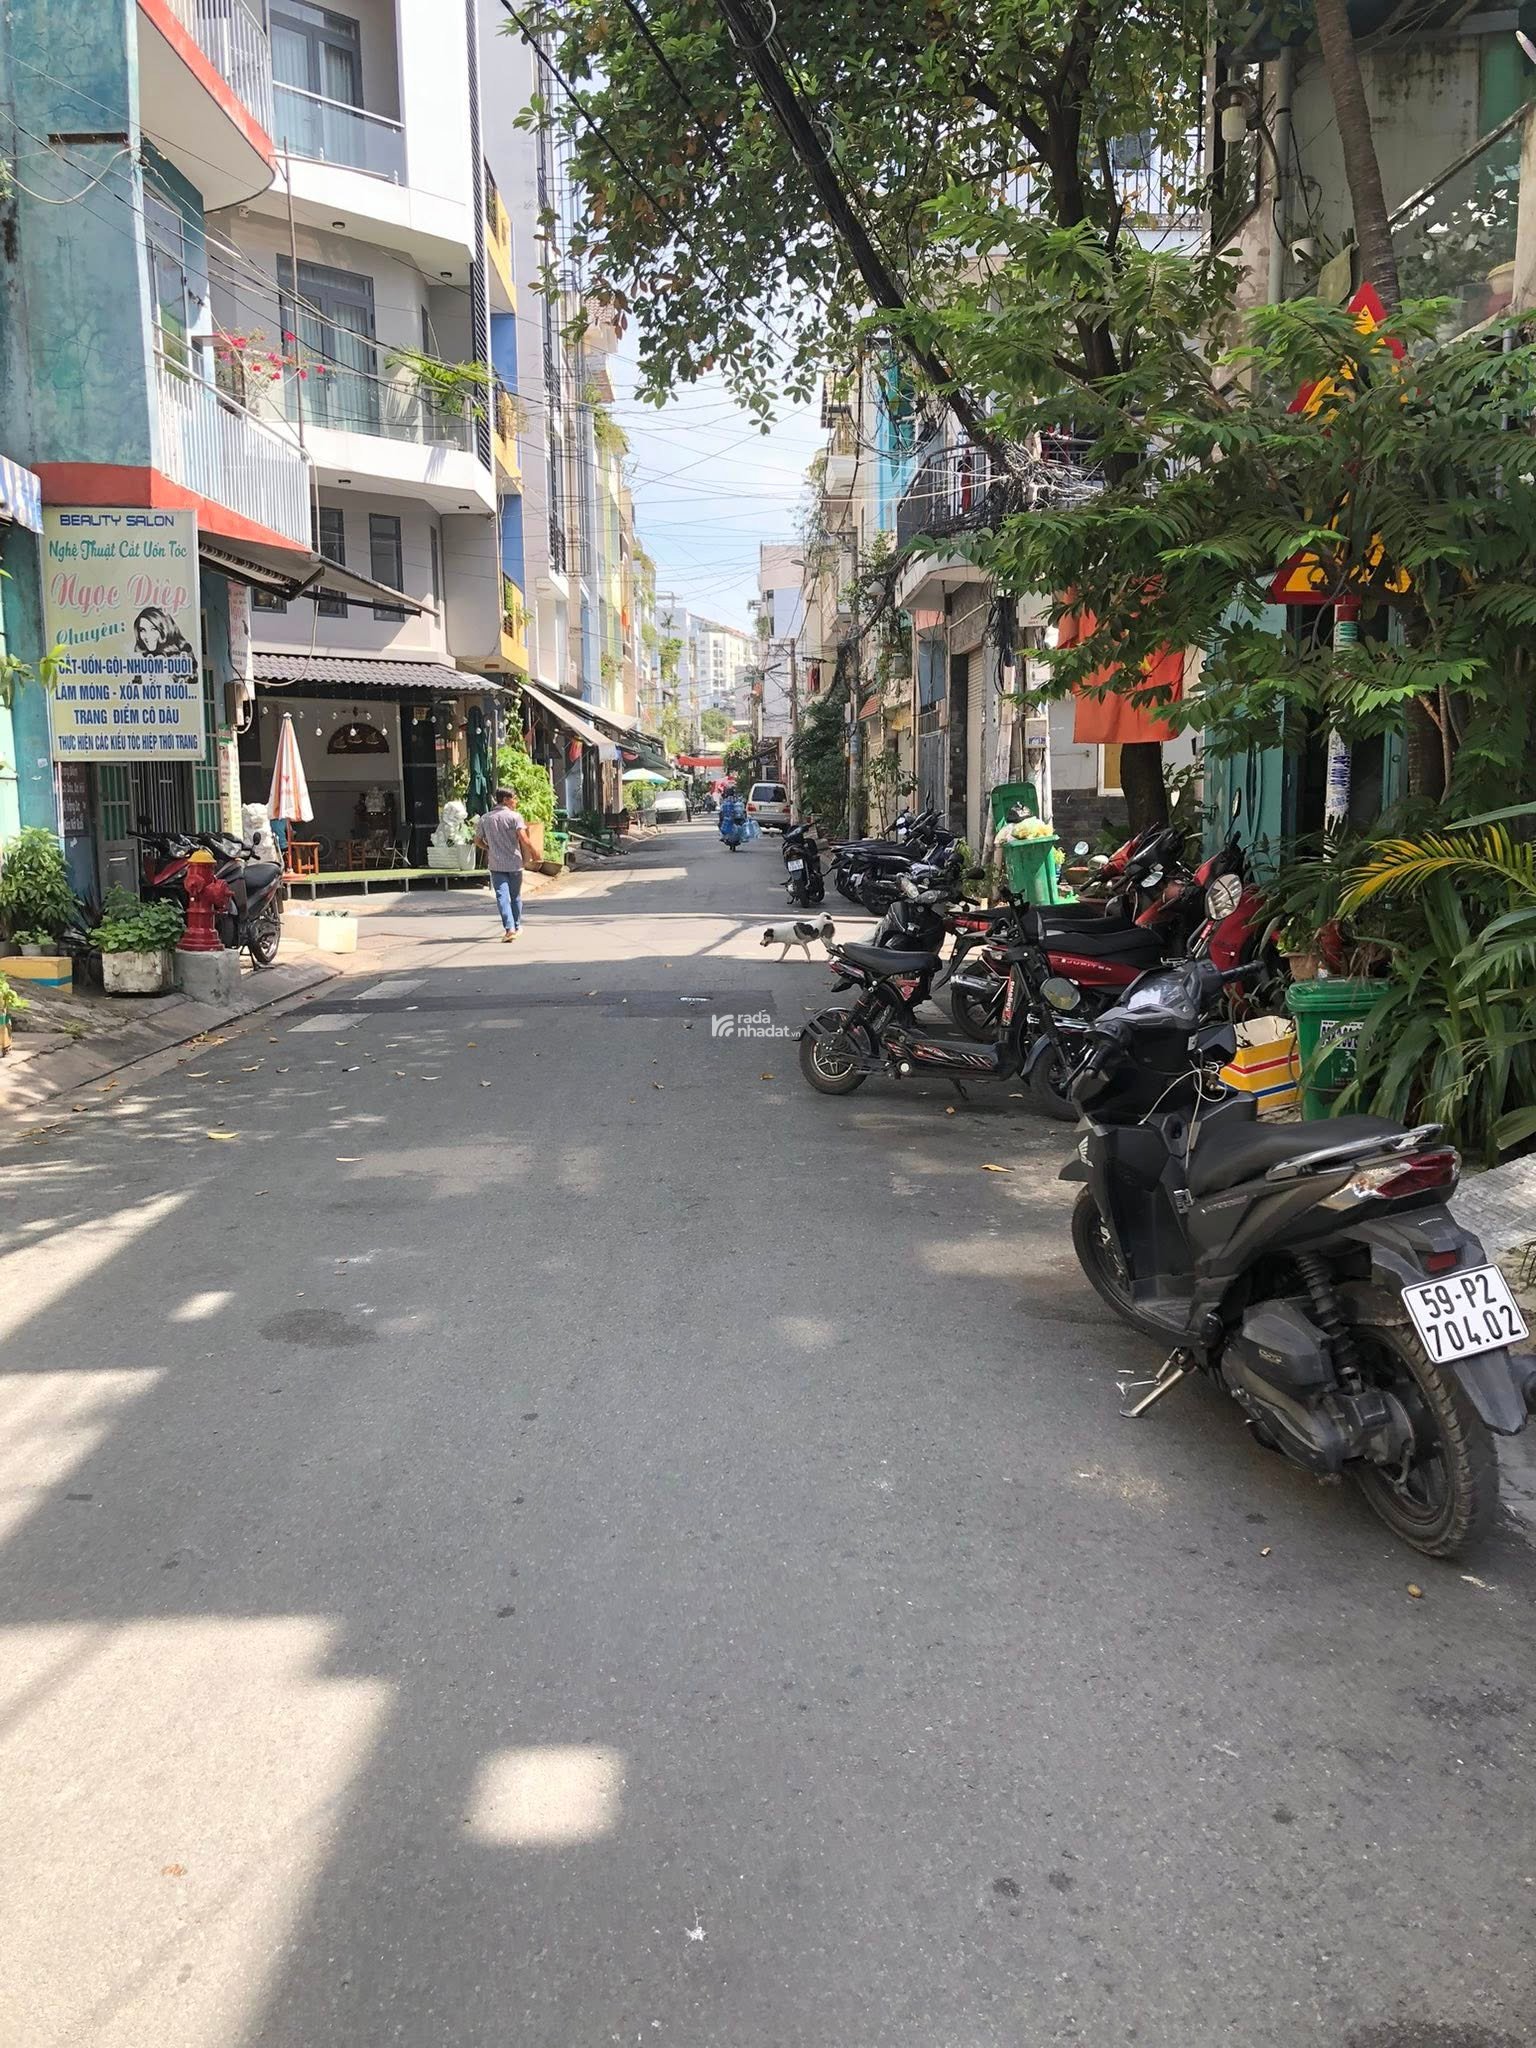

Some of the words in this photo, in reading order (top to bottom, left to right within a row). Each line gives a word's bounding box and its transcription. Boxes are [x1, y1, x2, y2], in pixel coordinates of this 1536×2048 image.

[60, 514, 122, 526] BEAUTY
[126, 515, 174, 527] SALON
[49, 540, 79, 562] Nghệ
[80, 540, 117, 561] Thuật
[119, 540, 141, 558] Cắt
[143, 540, 167, 558] Uốn
[168, 540, 188, 558] Tóc
[50, 572, 121, 617] Ngọc
[126, 573, 192, 617] Diệp
[56, 682, 77, 700] LÀM
[80, 682, 110, 700] MÓNG
[119, 682, 140, 700] XÓA
[142, 680, 162, 700] NỐT
[74, 709, 108, 725] TRANG
[113, 703, 139, 724] ĐIỂM
[142, 706, 156, 724] CÔ
[159, 706, 179, 724] DÂU
[95, 732, 109, 751] CÁC
[127, 731, 141, 750] TÓC
[175, 734, 198, 750] TRANG
[1419, 1274, 1497, 1319] 59-P2
[1425, 1305, 1522, 1358] 704.02
